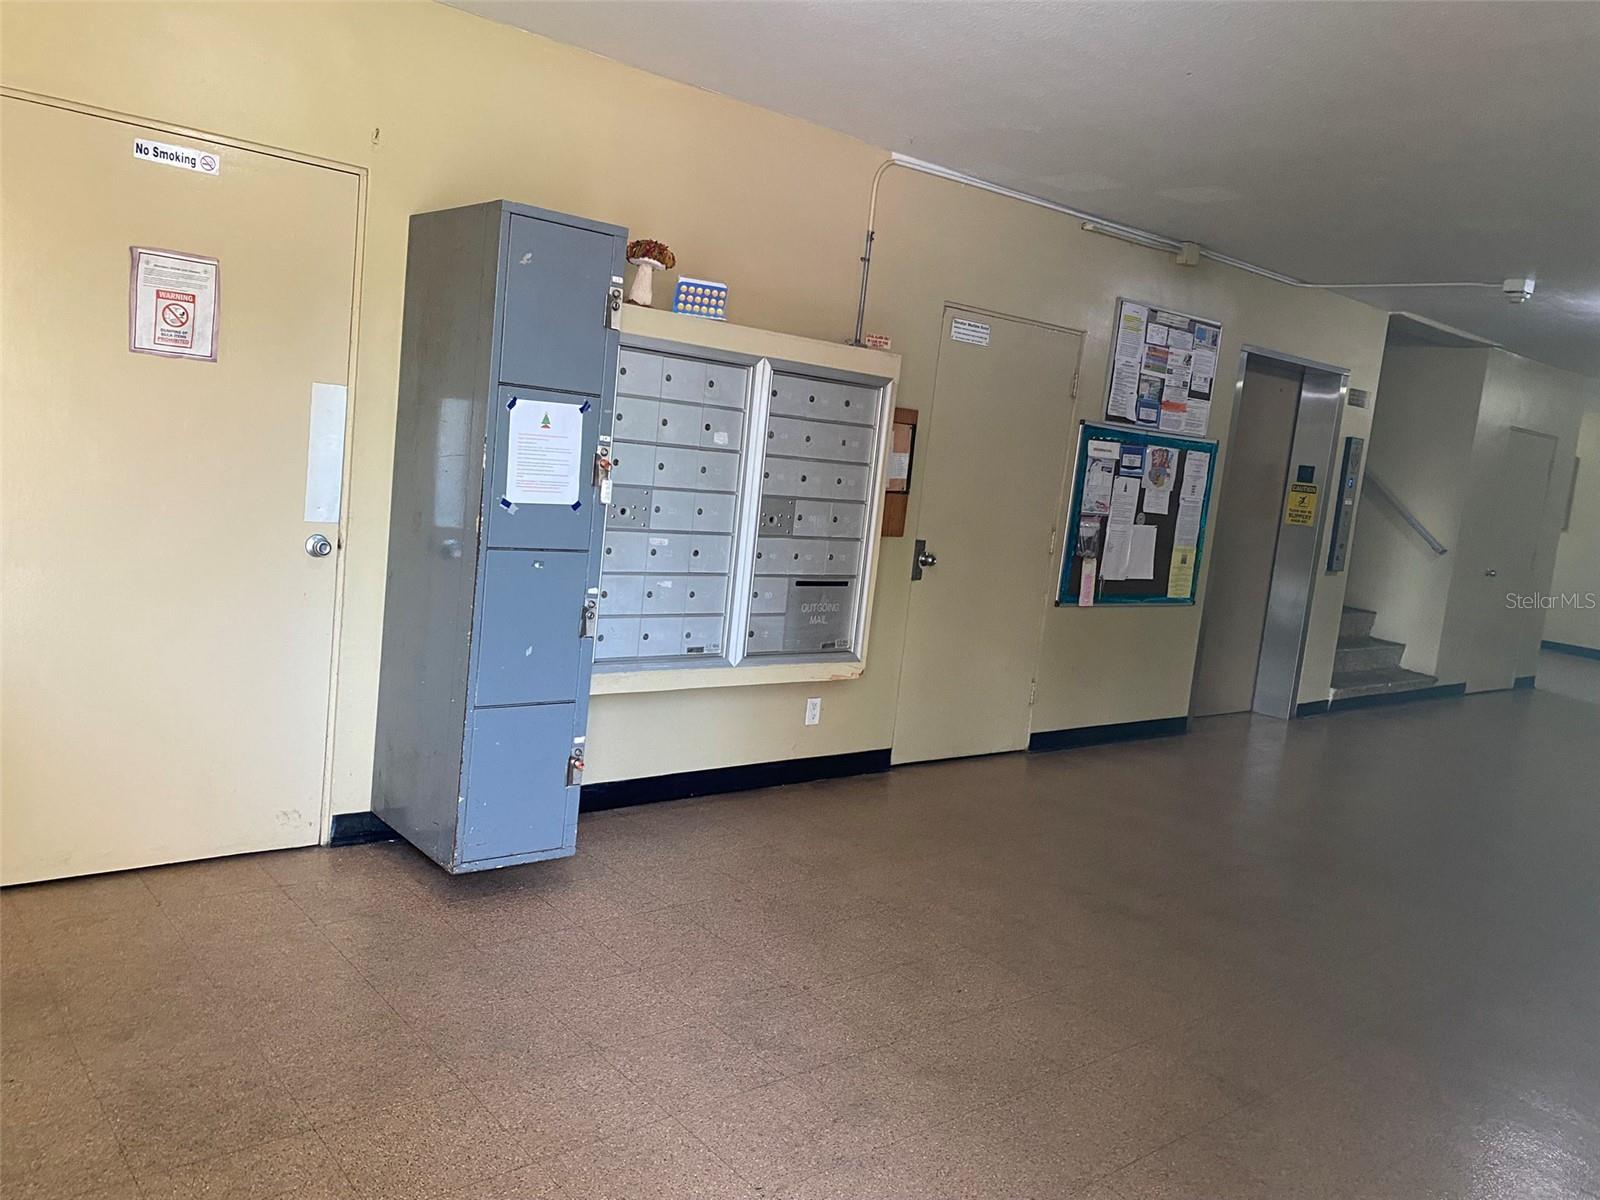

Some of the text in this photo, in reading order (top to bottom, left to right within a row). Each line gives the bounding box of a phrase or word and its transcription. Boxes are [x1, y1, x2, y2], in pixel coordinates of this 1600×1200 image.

[135, 142, 197, 169] No Smoking
[159, 291, 193, 302] WARNING
[801, 602, 841, 613] OUTGOING
[809, 615, 829, 625] MAIL
